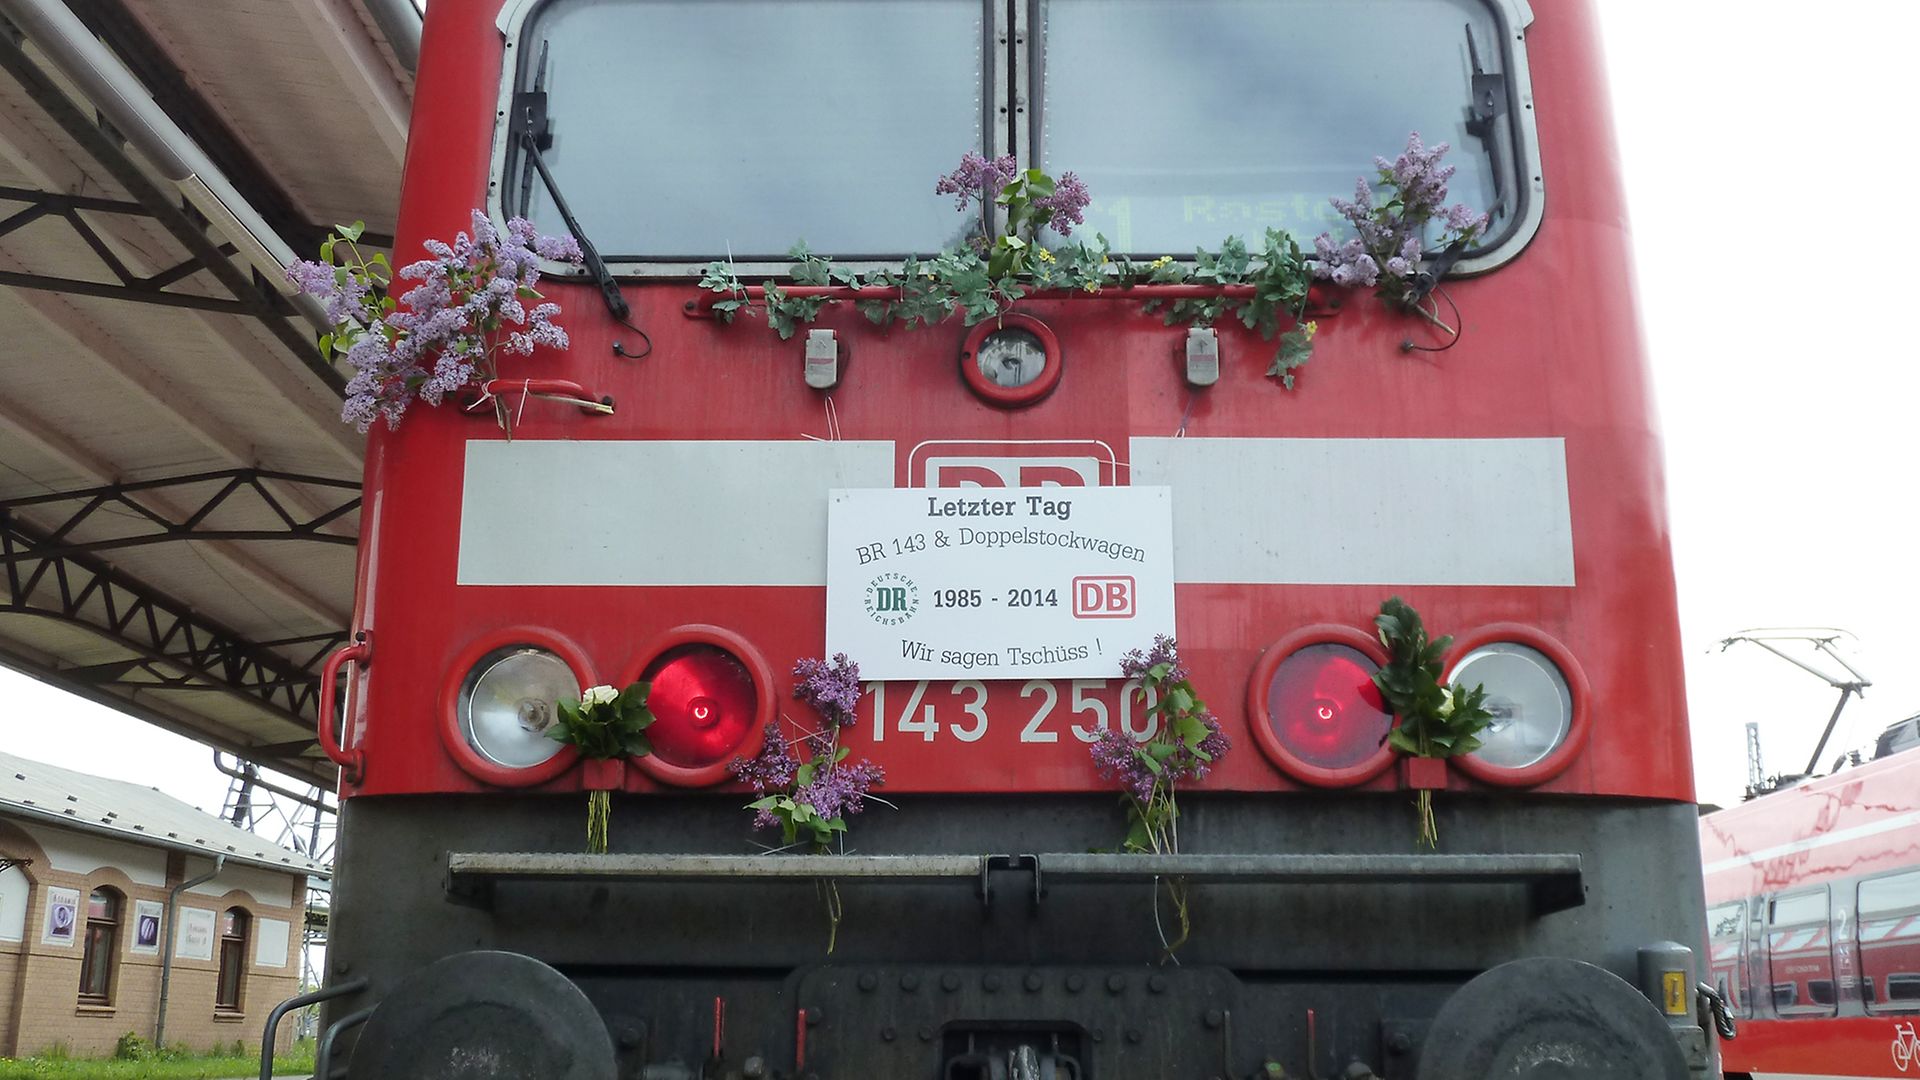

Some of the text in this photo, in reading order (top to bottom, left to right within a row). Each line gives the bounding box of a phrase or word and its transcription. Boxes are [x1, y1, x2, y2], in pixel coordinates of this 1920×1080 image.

[927, 495, 1072, 521] Letzter Tag
[855, 526, 1146, 566] BR 143 & Doppelstockwagen
[865, 572, 918, 594] DEUTSCHE
[1080, 582, 1128, 612] DB
[864, 598, 920, 626] REICHSBAHN
[876, 587, 908, 612] DR
[933, 589, 982, 608] 1985
[1007, 588, 1058, 608] 2014
[901, 637, 1103, 670] Wir sagen Tschüss !
[866, 679, 1159, 743] 143 250
